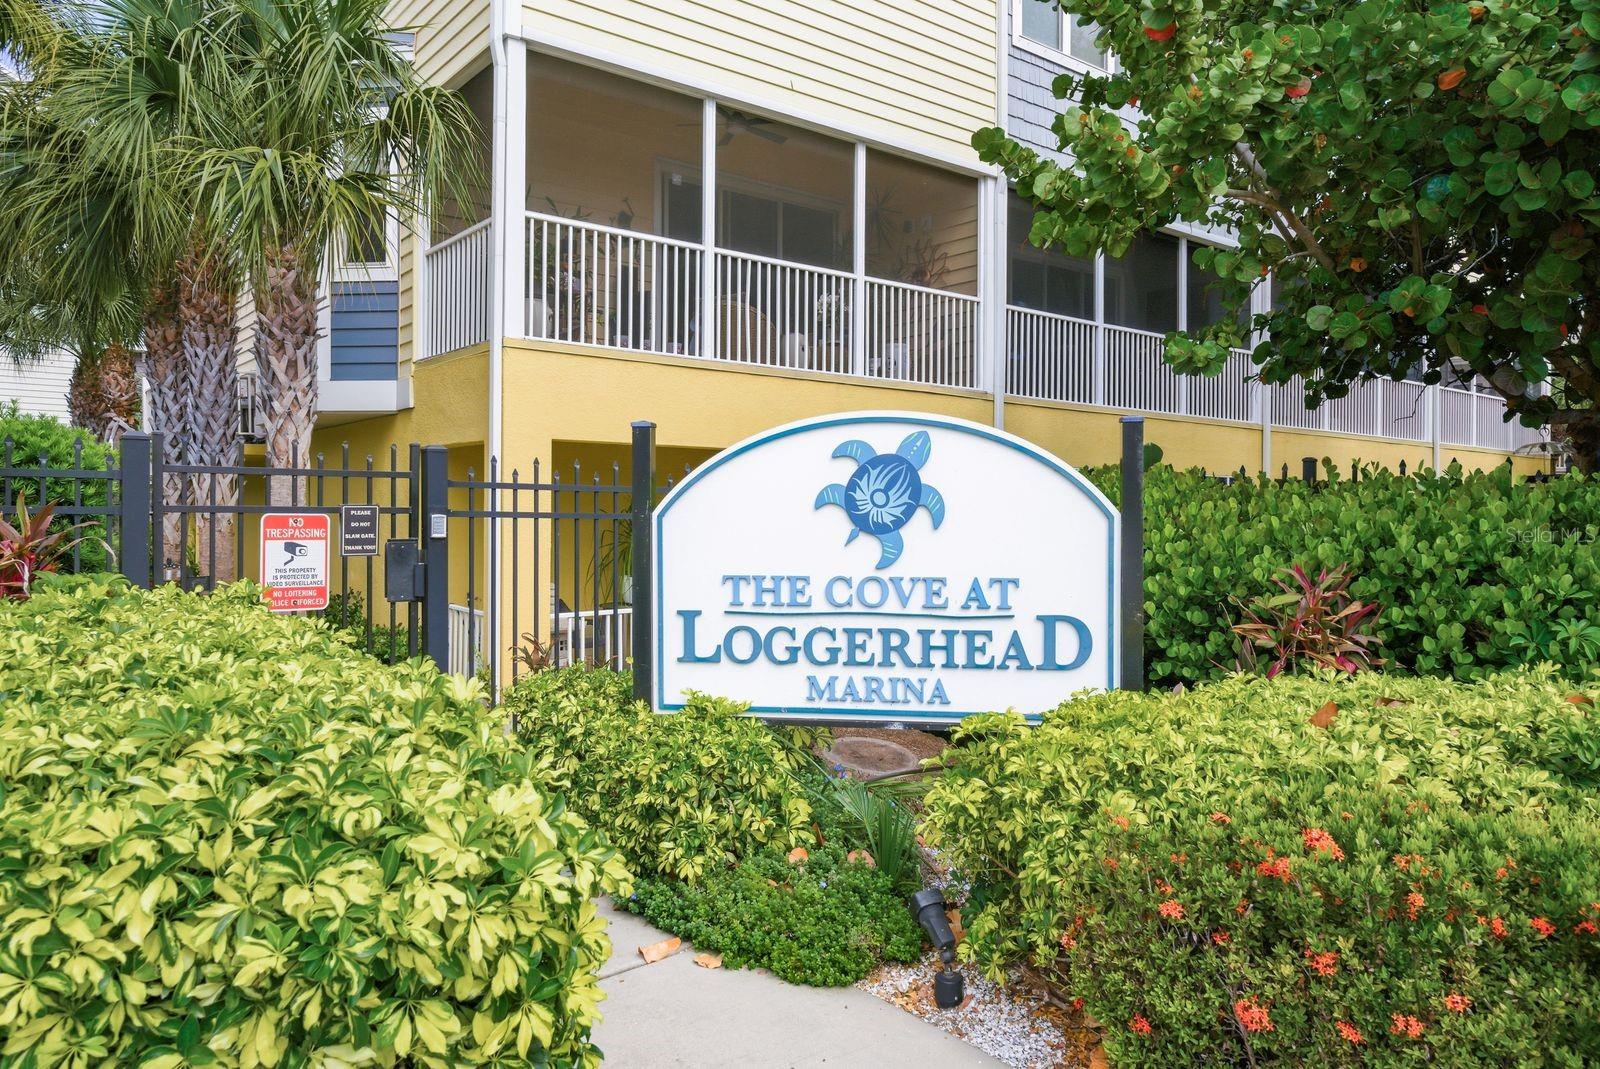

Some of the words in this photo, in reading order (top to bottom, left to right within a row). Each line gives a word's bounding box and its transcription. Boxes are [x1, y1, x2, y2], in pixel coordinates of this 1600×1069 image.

[288, 517, 304, 527] NO
[265, 528, 326, 538] TRESPASSING
[284, 589, 317, 597] LOITERING
[722, 574, 812, 607] THE
[824, 575, 949, 609] COVE
[960, 576, 1020, 610] AT
[676, 609, 1093, 671] LOGGERHEAD
[805, 675, 950, 705] MARINA
